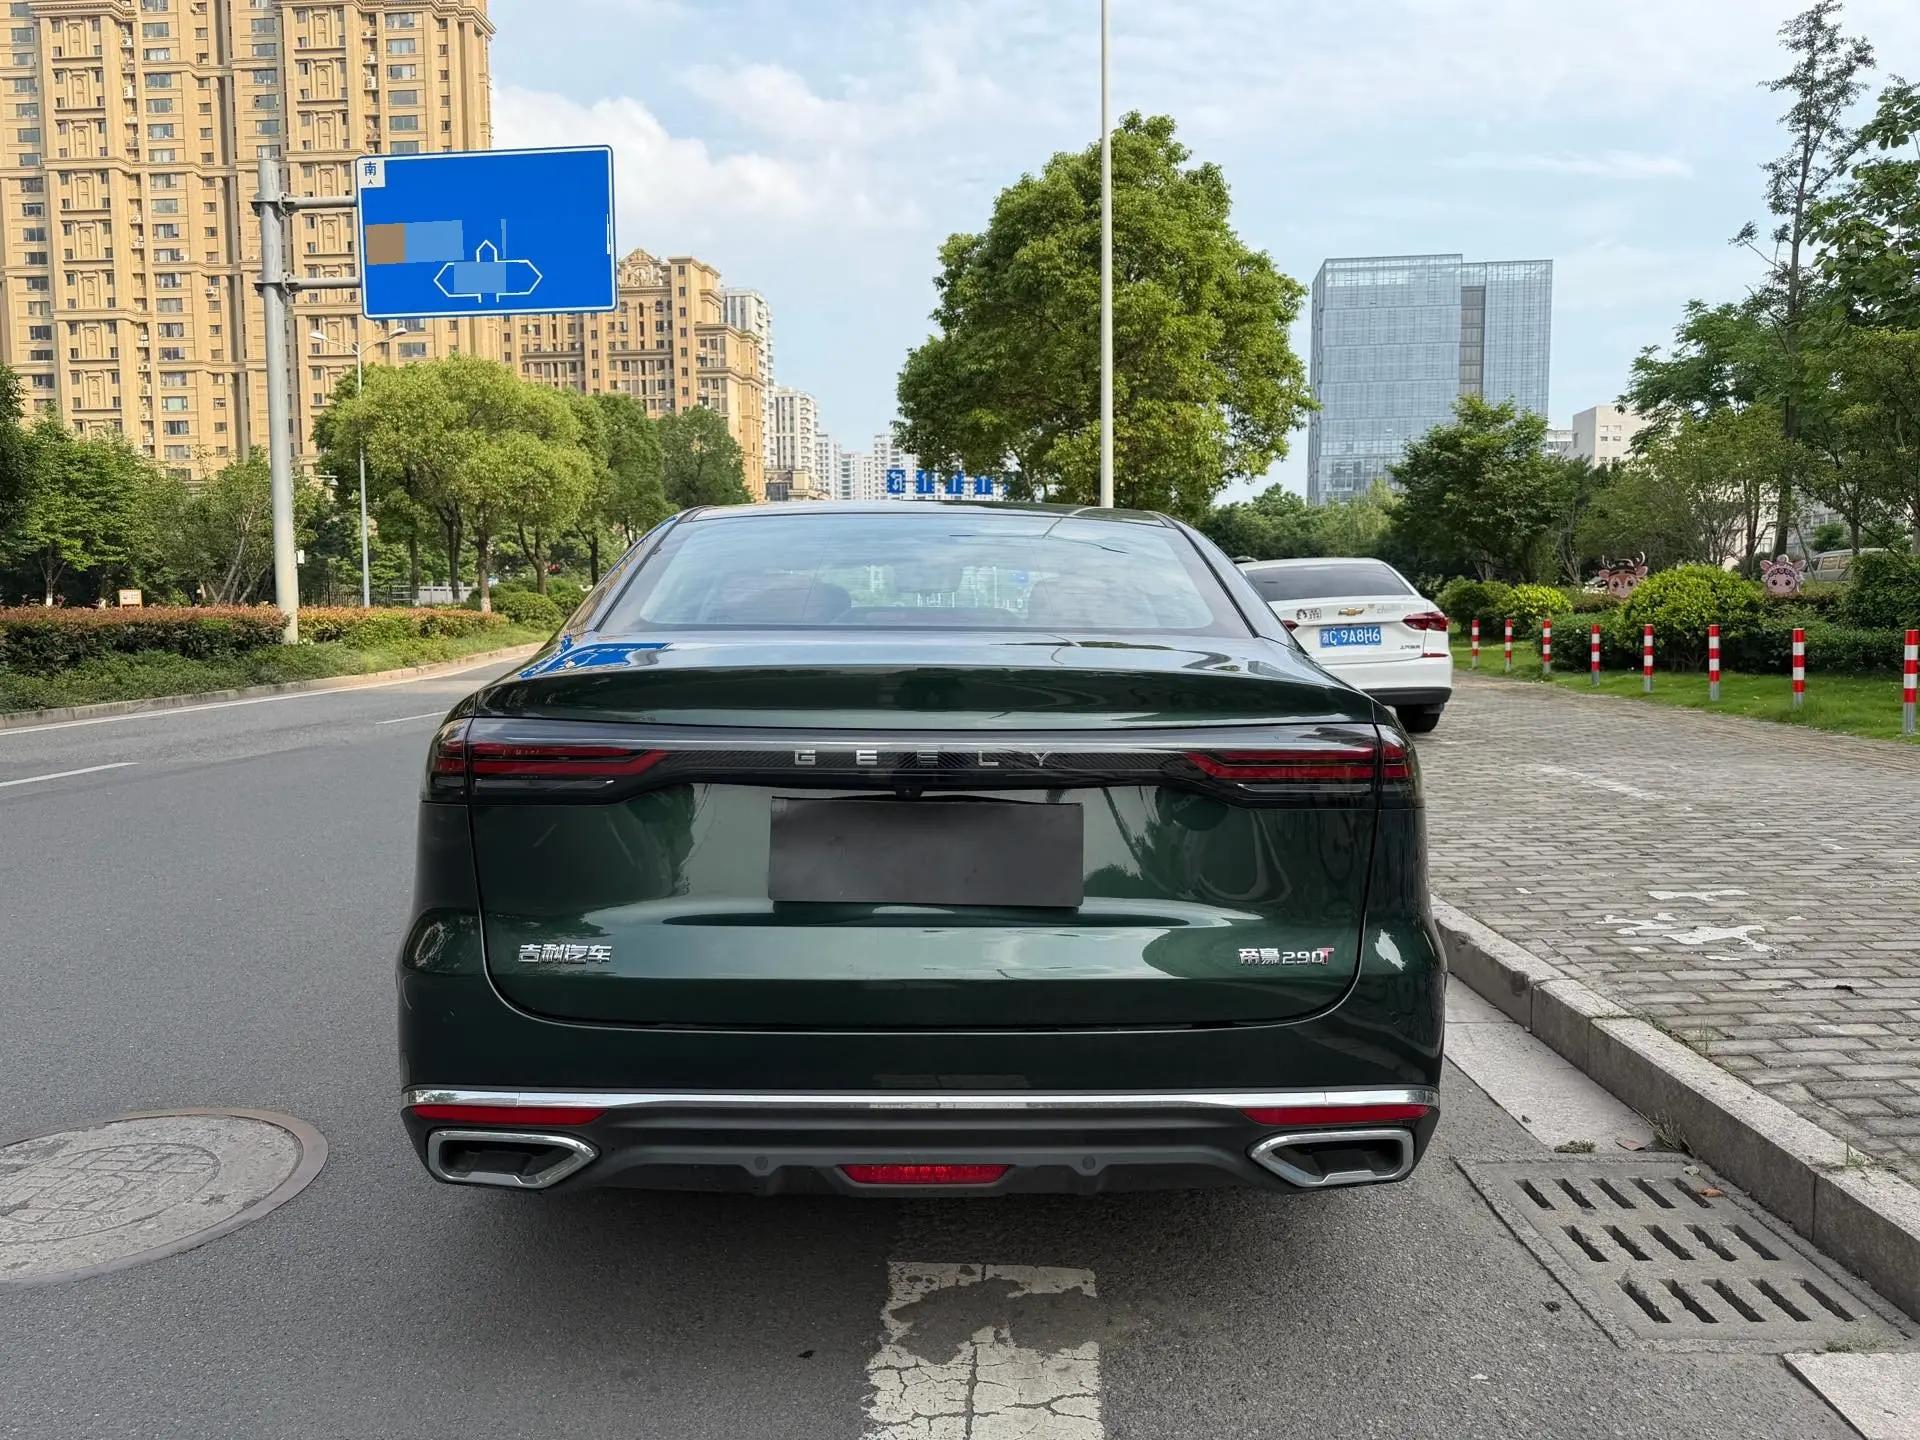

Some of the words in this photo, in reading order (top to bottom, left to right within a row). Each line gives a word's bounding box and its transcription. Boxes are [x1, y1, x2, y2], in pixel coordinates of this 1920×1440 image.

[364, 161, 377, 177] 南
[794, 748, 1051, 766] GEELY
[518, 944, 612, 963] 吉利汽车
